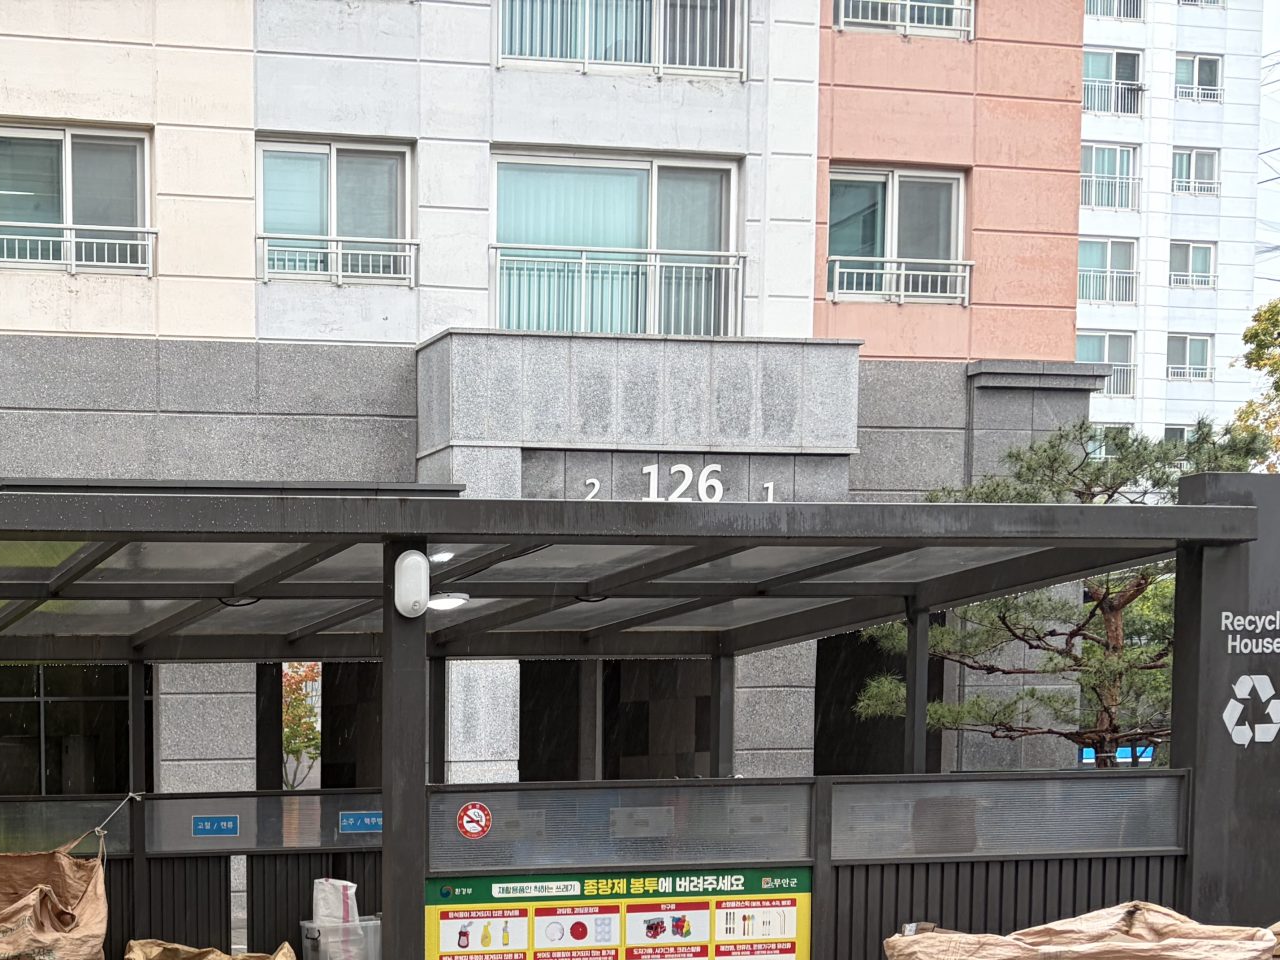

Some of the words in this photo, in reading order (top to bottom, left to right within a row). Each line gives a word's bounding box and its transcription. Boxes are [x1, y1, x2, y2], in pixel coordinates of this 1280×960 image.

[584, 478, 601, 501] 2
[641, 463, 724, 502] 126
[763, 481, 774, 503] 1
[555, 884, 576, 892] 쓰레기
[584, 878, 626, 895] 종량제
[630, 877, 672, 894] 봉투에
[675, 875, 745, 892] 버려주세요
[773, 878, 798, 888] 무안군
